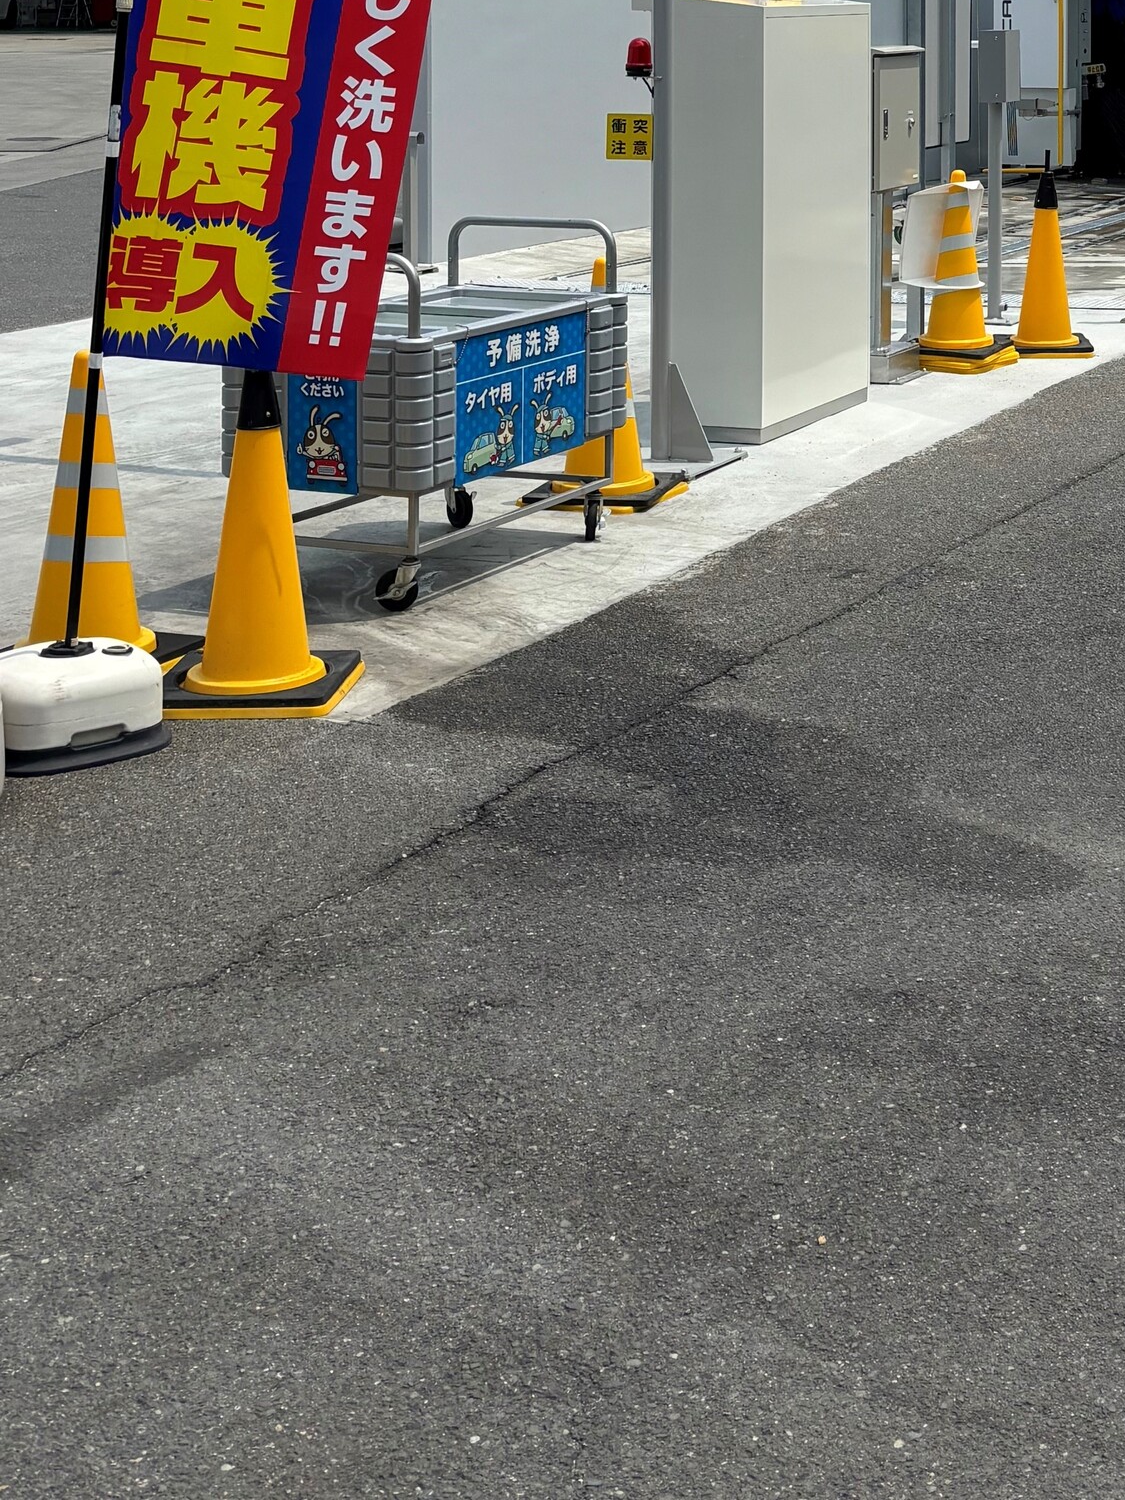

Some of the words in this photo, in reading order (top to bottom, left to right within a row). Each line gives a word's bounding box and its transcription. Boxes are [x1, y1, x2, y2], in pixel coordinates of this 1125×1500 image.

[611, 118, 648, 134] 衝突
[611, 140, 648, 155] 注意
[107, 234, 254, 322] 導入
[486, 325, 560, 367] 予備洗浄
[300, 382, 344, 397] ください
[533, 364, 577, 394] ボディ用
[465, 382, 512, 413] タイヤ用
